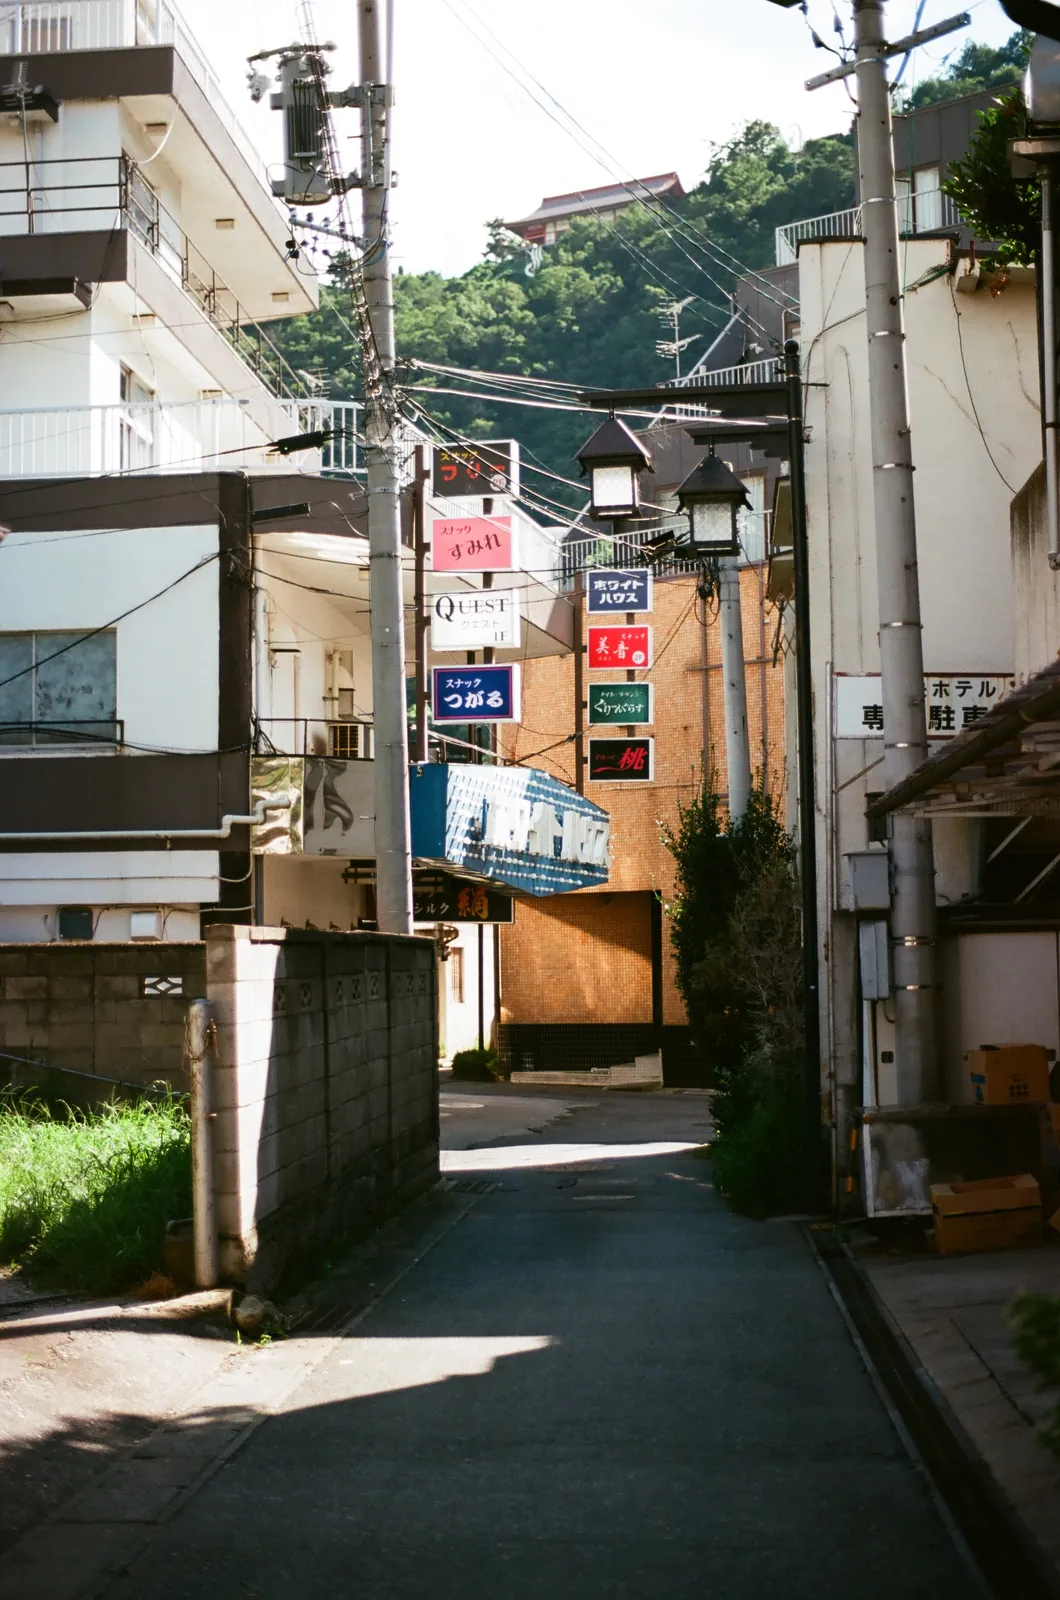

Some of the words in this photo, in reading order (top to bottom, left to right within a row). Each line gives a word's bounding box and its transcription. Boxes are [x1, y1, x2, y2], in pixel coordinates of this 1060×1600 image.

[440, 525, 471, 536] スナック
[448, 533, 501, 561] すみれ
[593, 580, 644, 591] ホワイト
[599, 593, 638, 604] ハウス
[435, 595, 508, 622] QUEST
[461, 620, 499, 630] クエスト
[494, 631, 508, 641] 1F
[595, 636, 629, 660] 美音
[445, 678, 481, 688] スナック
[923, 680, 996, 699] ホテル
[444, 690, 503, 708] つがる
[594, 699, 644, 716] ぐりーんぐらす
[862, 704, 988, 731] 専駐車
[619, 747, 648, 770] 桃
[414, 902, 450, 915] シルク
